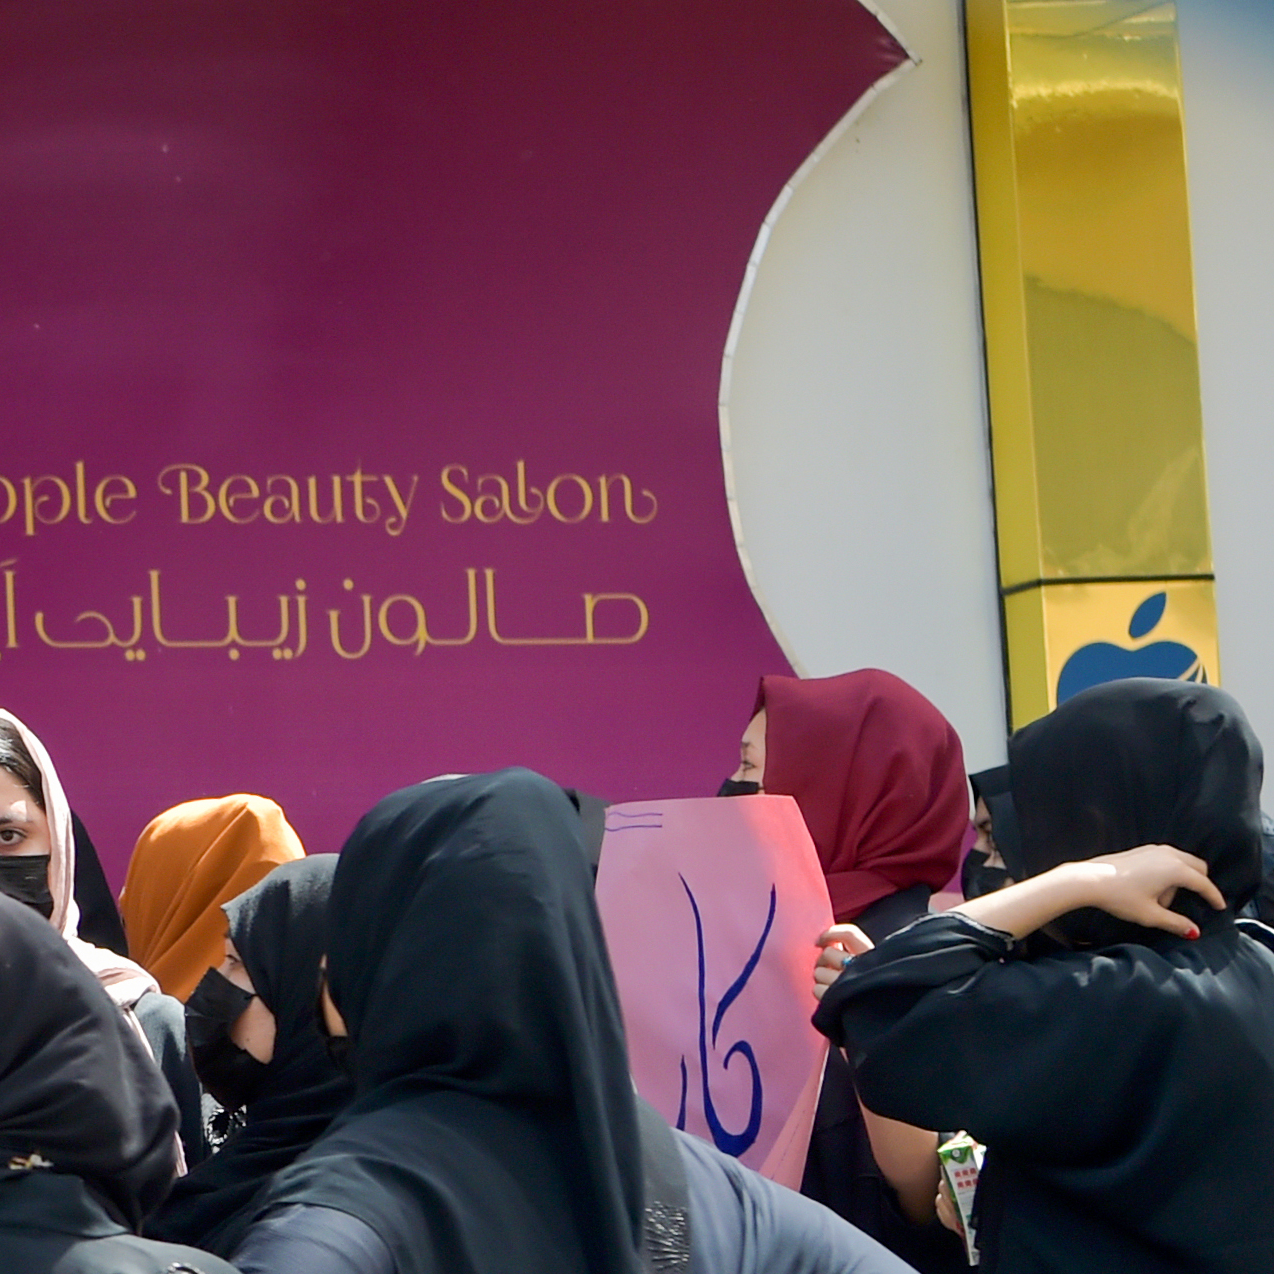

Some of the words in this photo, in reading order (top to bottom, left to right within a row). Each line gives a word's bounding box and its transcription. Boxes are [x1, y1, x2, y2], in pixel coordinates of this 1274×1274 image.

[158, 459, 419, 536] Beauty
[439, 459, 658, 525] Salon
[34, 568, 309, 662] زیبایی
[326, 567, 649, 660] صالون
